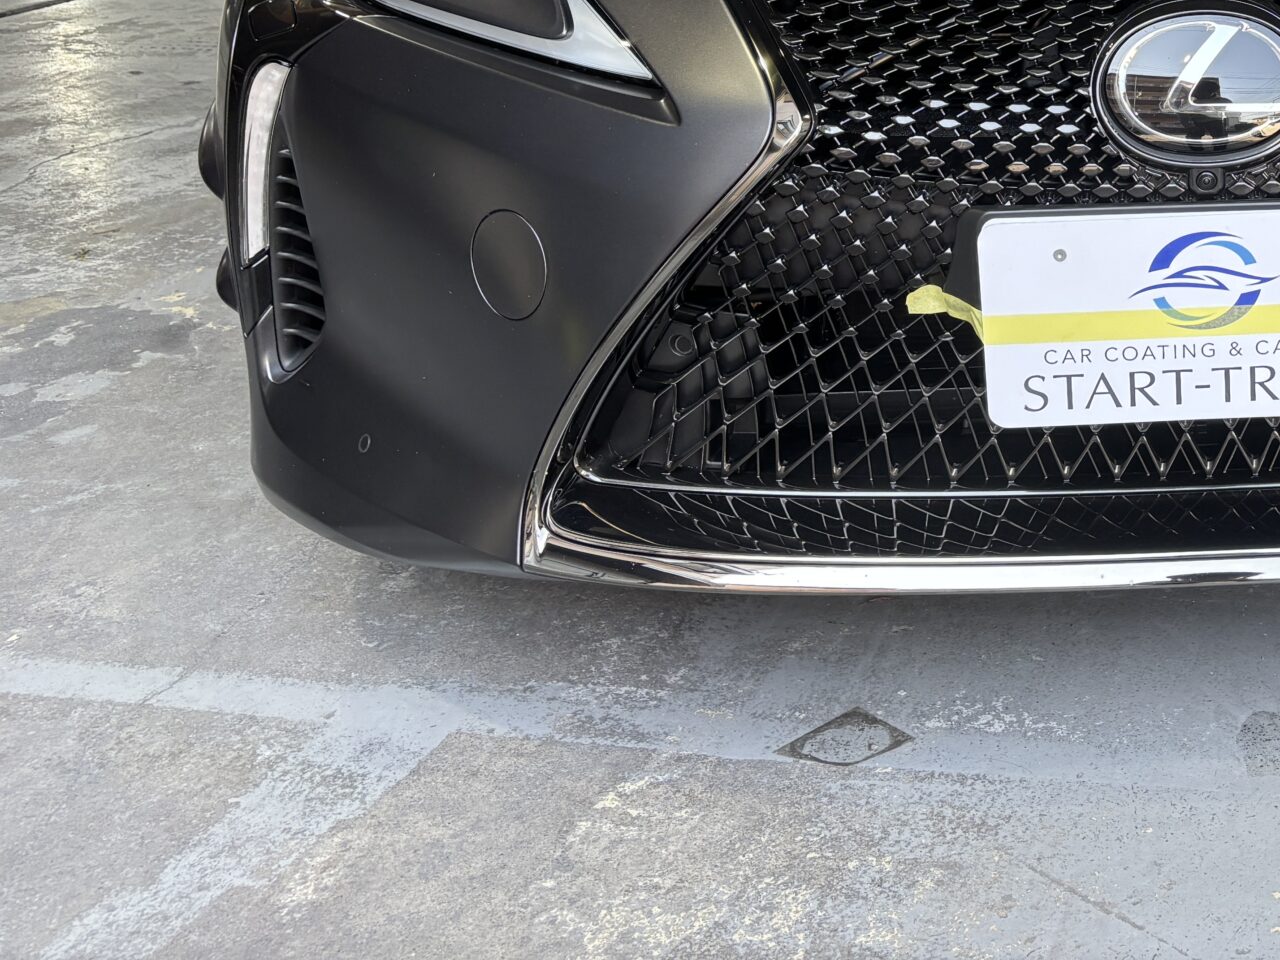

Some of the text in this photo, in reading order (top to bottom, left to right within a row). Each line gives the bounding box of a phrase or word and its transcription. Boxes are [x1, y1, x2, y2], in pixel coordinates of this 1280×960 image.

[1043, 348, 1092, 365] CAR
[1104, 342, 1216, 363] COATING
[1228, 341, 1243, 357] &
